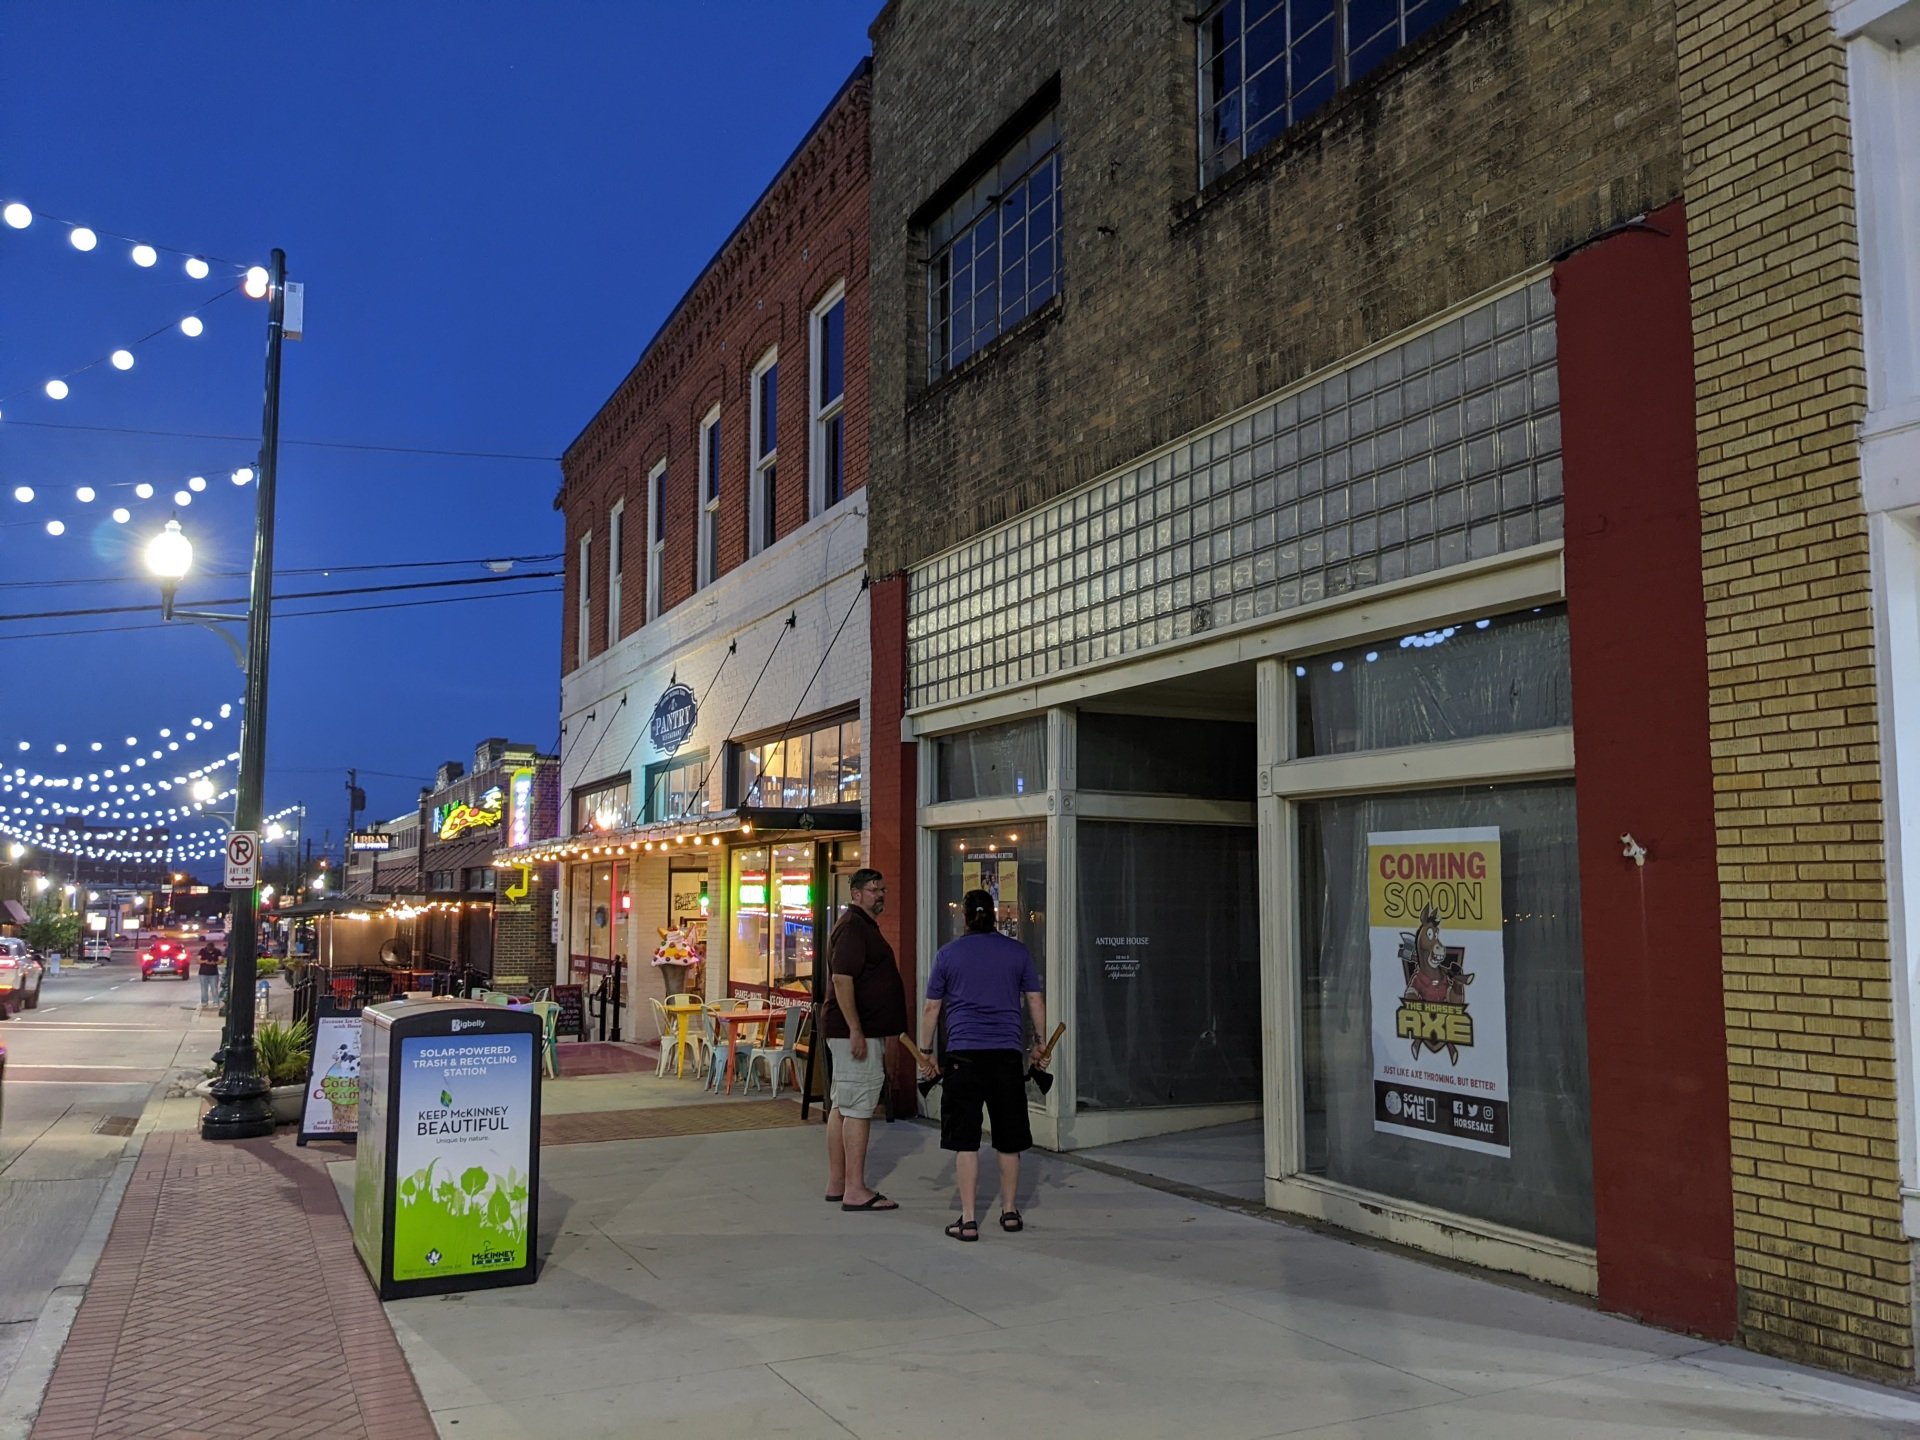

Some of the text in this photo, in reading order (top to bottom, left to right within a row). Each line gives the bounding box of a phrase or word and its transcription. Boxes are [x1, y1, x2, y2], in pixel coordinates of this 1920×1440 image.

[655, 705, 691, 736] PANTRY
[229, 867, 252, 875] ANY TIME
[1380, 851, 1486, 880] COMING
[1384, 882, 1483, 920] SOON
[1095, 937, 1150, 947] ANTIQUE HOUSE
[1406, 1002, 1423, 1011] THE
[451, 1019, 486, 1032] Bigbelly
[1398, 1009, 1473, 1044] AXE
[420, 1046, 511, 1058] SOLAR-POWERED
[413, 1055, 517, 1069] TRASH & RECYCLING
[443, 1067, 487, 1078] STATION
[1383, 1065, 1396, 1075] JUST
[1396, 1068, 1410, 1078] LIKE
[1411, 1070, 1423, 1080] AXE
[1457, 1076, 1469, 1087] BUT
[1470, 1078, 1496, 1092] BETTER!
[313, 1088, 360, 1100] Cream
[1403, 1093, 1425, 1105] SCAN
[418, 1106, 509, 1121] KEEP McKINNEY
[1403, 1103, 1426, 1122] ME
[417, 1117, 510, 1136] BEAUTIFUL
[1453, 1117, 1495, 1134] HORSESAXE
[471, 1250, 515, 1260] McKINNEY
